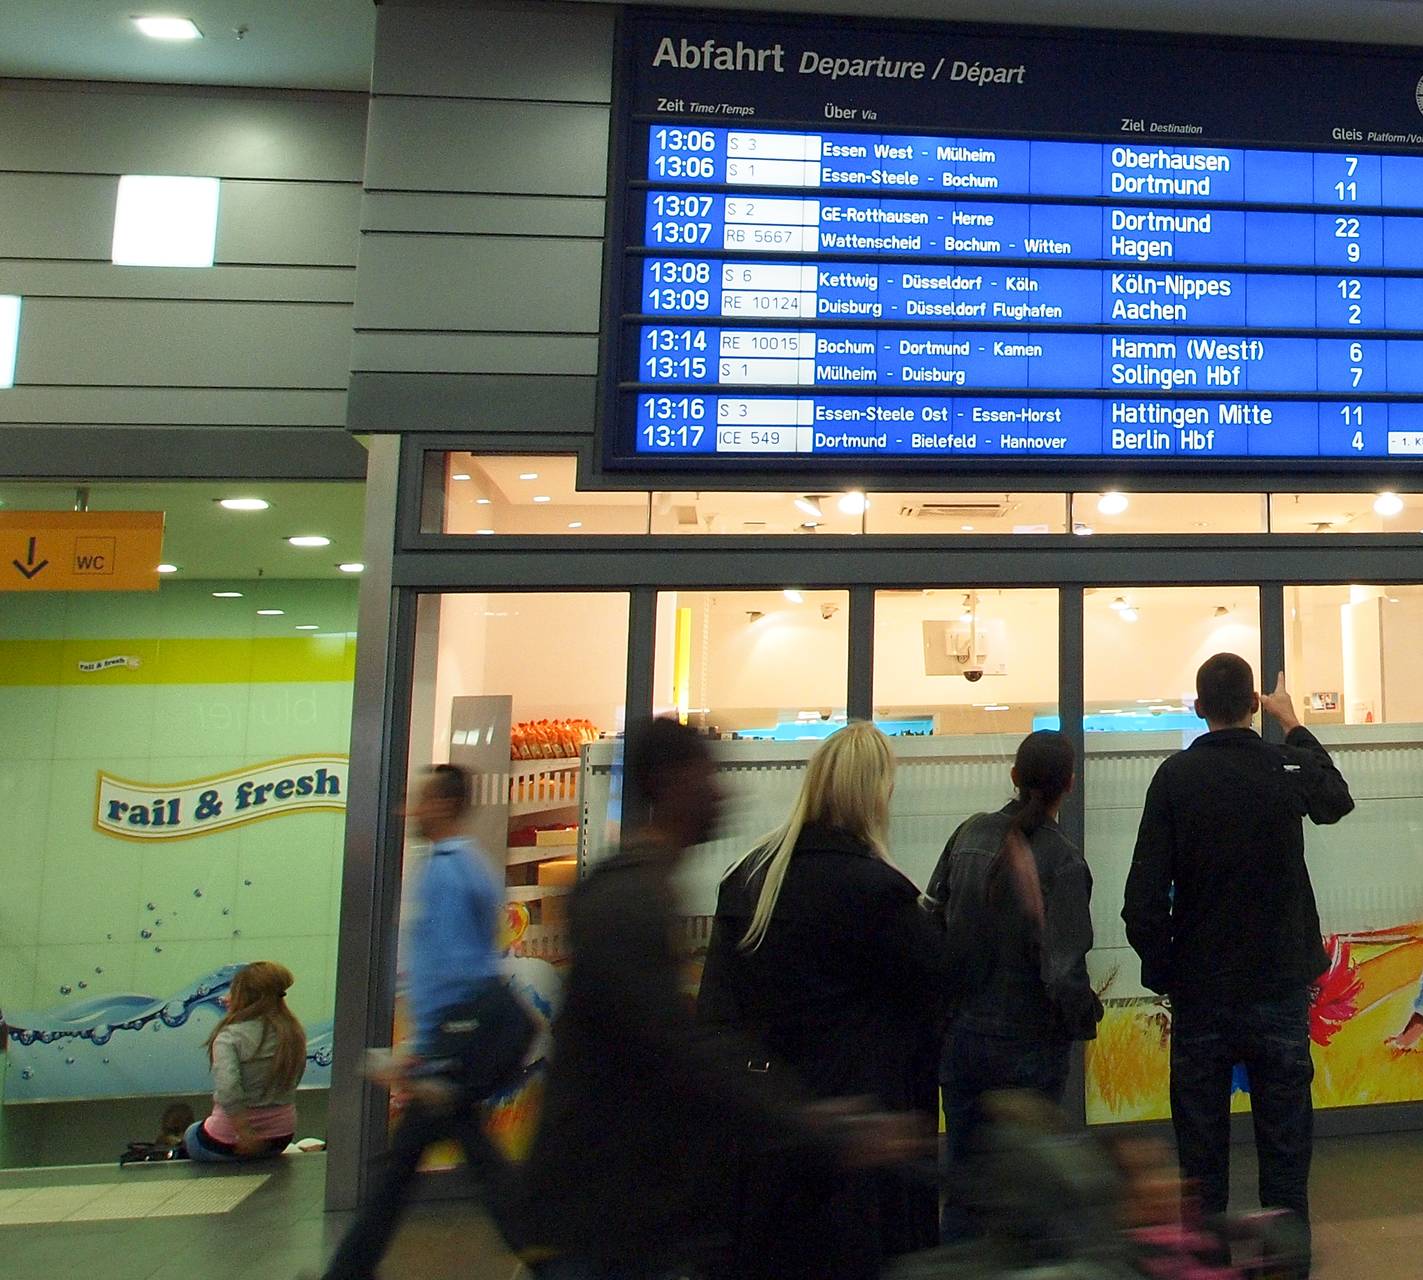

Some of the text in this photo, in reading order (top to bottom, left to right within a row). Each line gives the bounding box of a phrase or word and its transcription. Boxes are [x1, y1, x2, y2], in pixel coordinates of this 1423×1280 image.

[653, 38, 1025, 86] Abfahrt Departure Départ
[657, 99, 684, 111] Zeit
[690, 103, 754, 116] Time/Temps
[825, 103, 857, 118] Über
[862, 110, 877, 119] Via
[1121, 119, 1144, 131] Ziel
[1150, 123, 1202, 133] Destination
[1333, 128, 1362, 140] Gleis
[657, 130, 1229, 171] 13:06 Essen West Mülheim Oberhausen
[656, 156, 1209, 195] 13:06 Essen-Steele Bochum Dortmund
[654, 196, 1210, 232] 13:07 GE-Rotthausen Herne Dortmund
[653, 223, 1172, 261] 13:07 RB 5667 Wattenscheid Bochum Witten Hagen
[651, 262, 1230, 299] 13:08 Kettwig Düsseldorf Köln Köln-Nippes
[650, 289, 1186, 320] 13:09 RE 10124 Duisburg Düsseldorf Flughafen Aachen
[648, 330, 1263, 360] 13:14 RE 10015 Bochum Dortmund Kamen Hamm (Westf)
[647, 357, 1240, 389] 13:15 Mülheim Duisburg Solingen Hbf
[645, 399, 1271, 428] 13:16 Essen-Steele Ost Essen-Horst Hattingen Mitte
[644, 426, 1214, 449] 13:17 ICE 549 Dortmund Bielefeld Hannover Berlin Hbf
[76, 555, 105, 570] WC
[107, 768, 341, 826] rail & fresh
